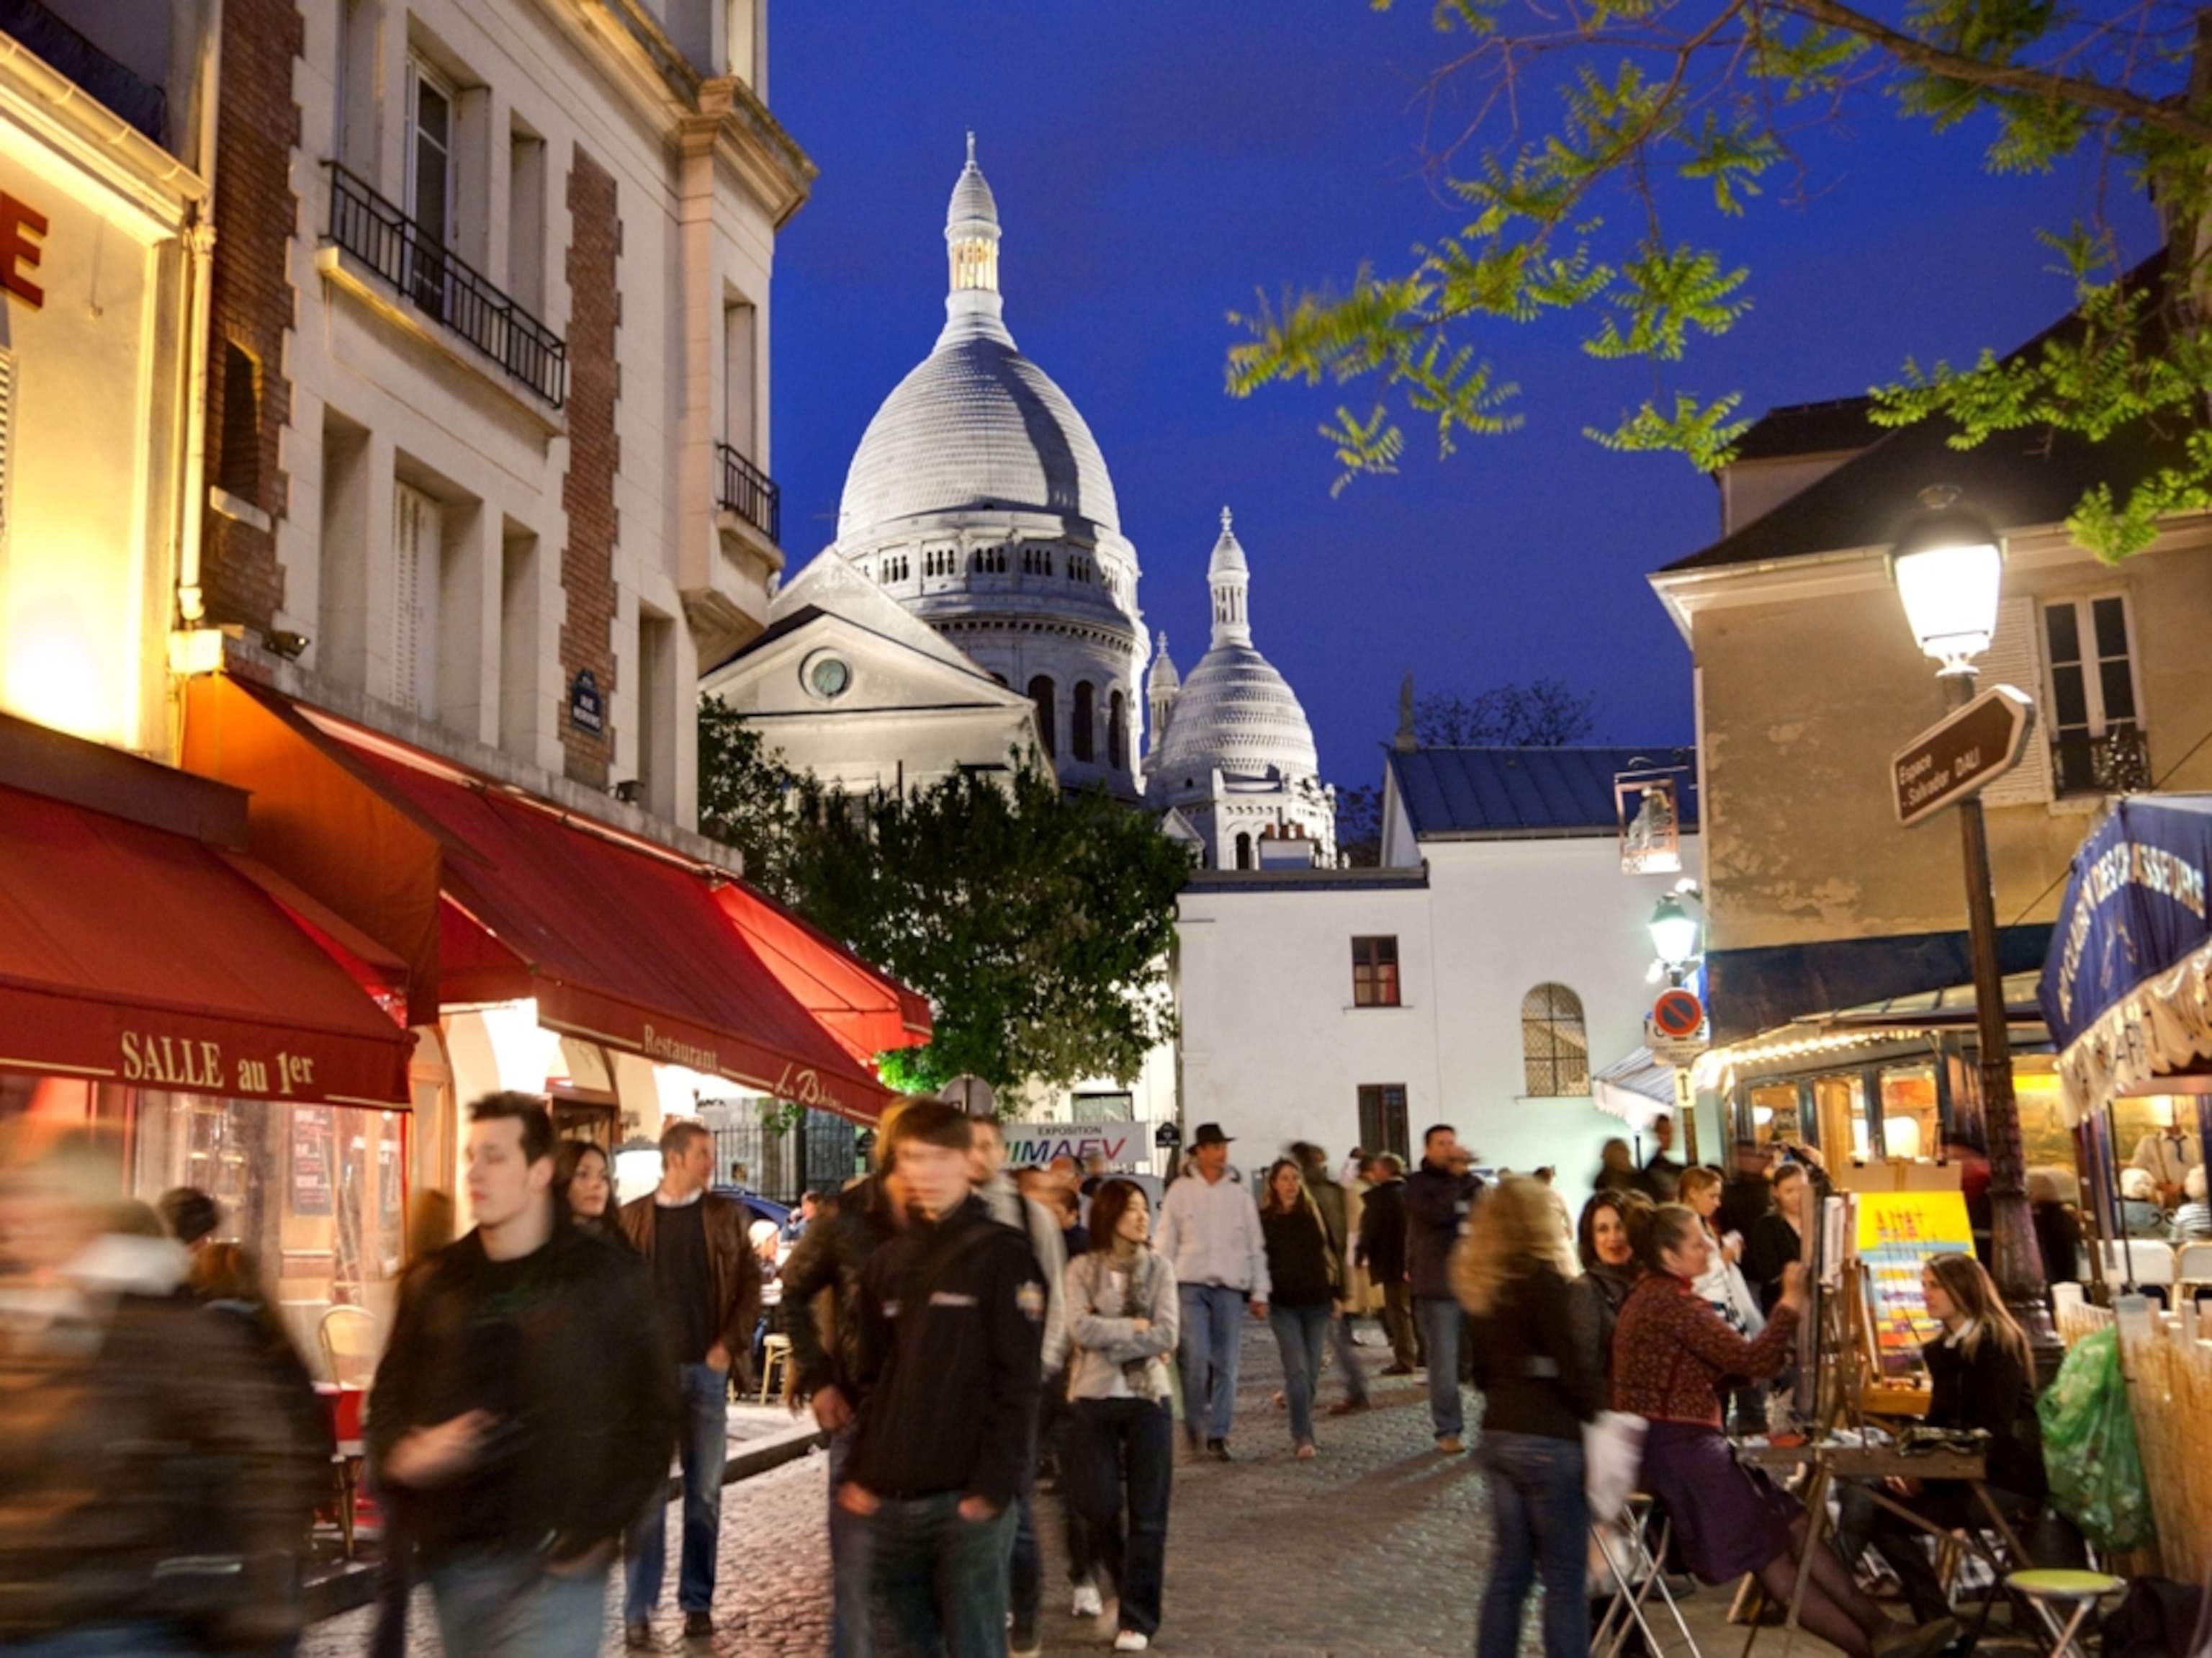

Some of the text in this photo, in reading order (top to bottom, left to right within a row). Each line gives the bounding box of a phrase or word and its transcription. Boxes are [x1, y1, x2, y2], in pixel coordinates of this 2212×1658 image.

[1899, 753, 1932, 786] Espace
[1907, 770, 1950, 806] Salvador
[122, 1031, 314, 1095] SALLE au 1er
[644, 1023, 718, 1072] Restaurant
[1038, 1125, 1102, 1136] EXPOSITION
